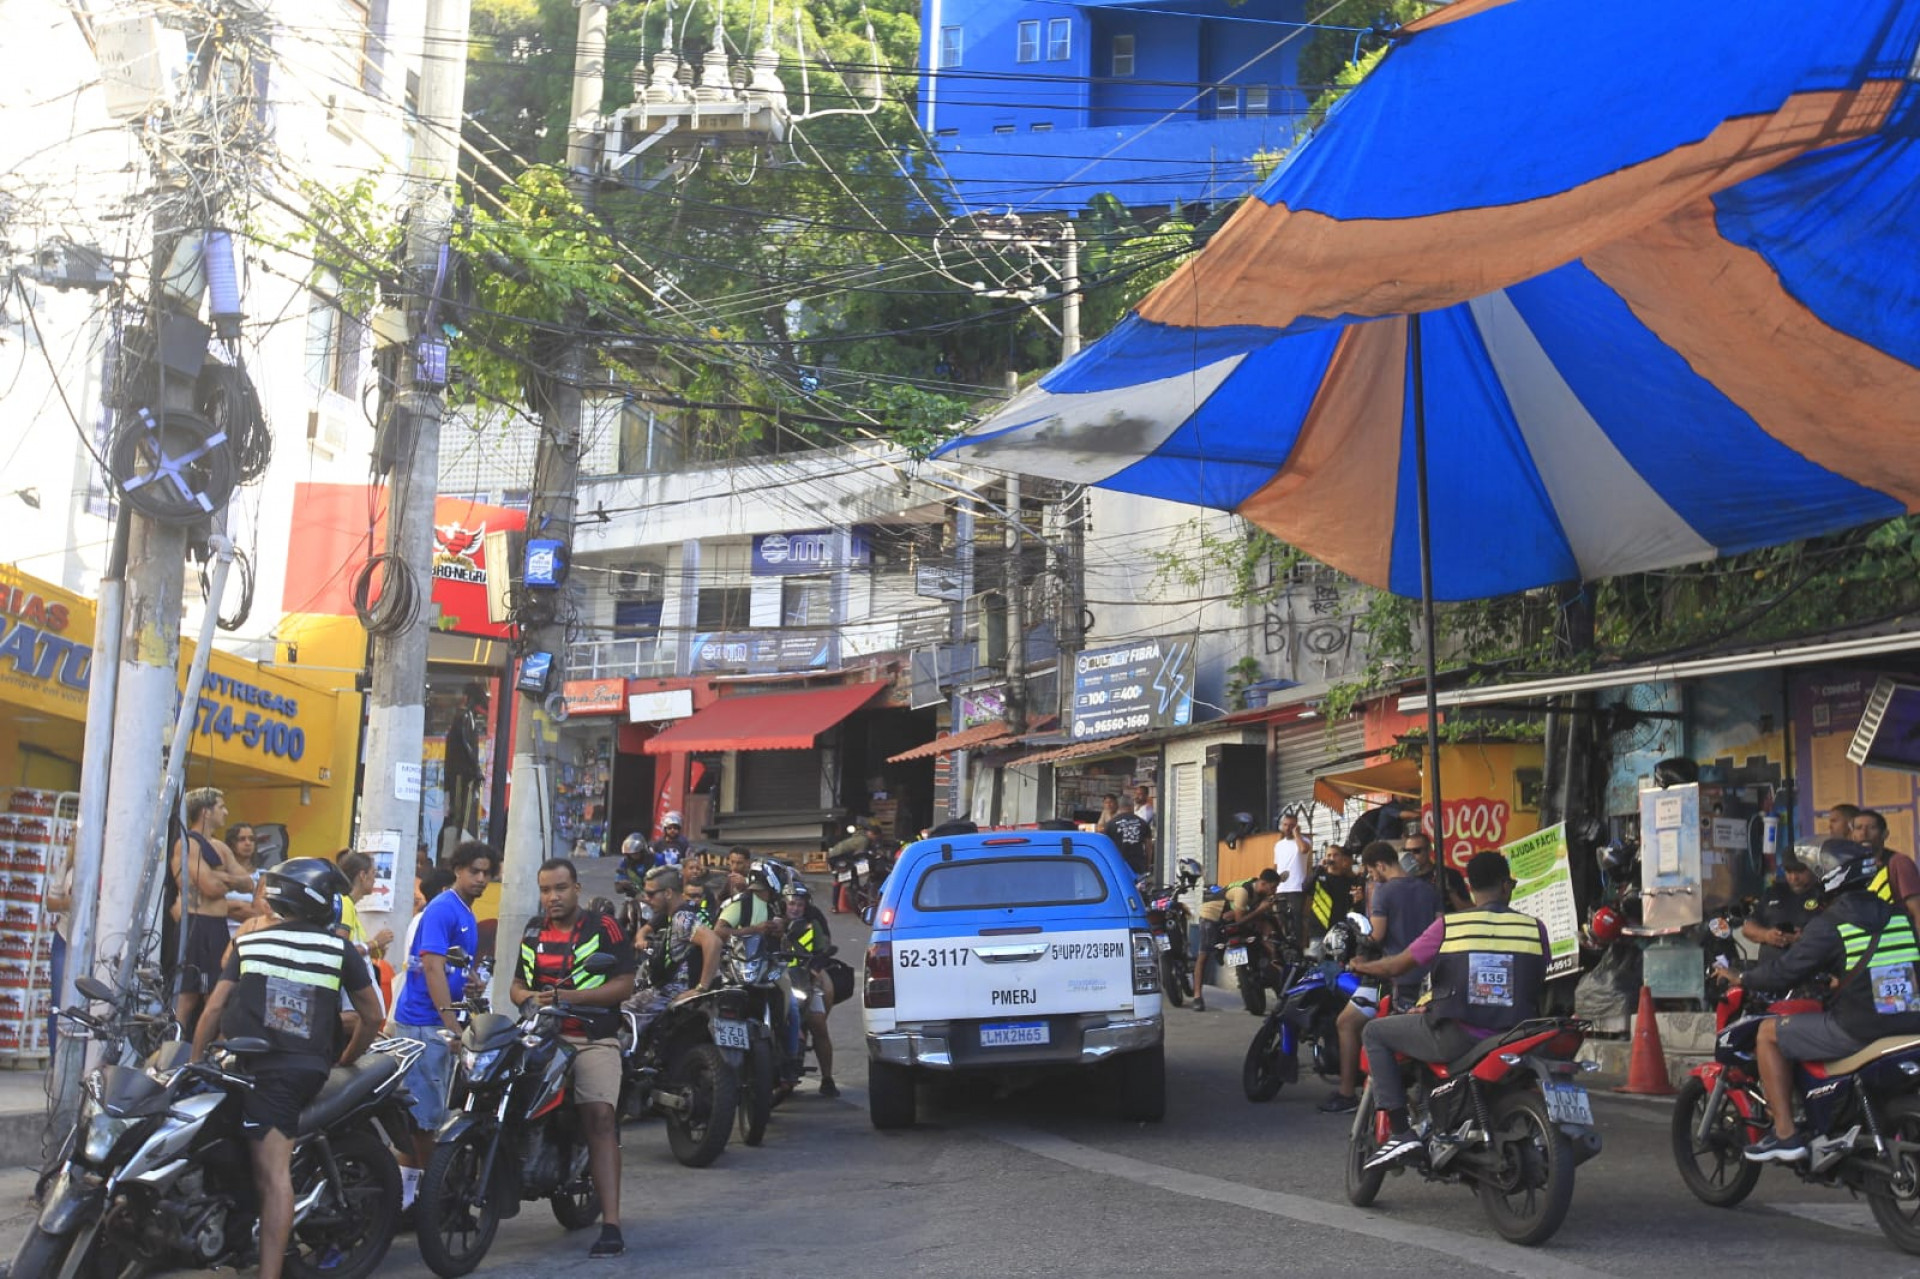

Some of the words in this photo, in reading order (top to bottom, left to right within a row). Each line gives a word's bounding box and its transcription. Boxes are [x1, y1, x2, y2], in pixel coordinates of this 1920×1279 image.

[0, 614, 93, 691] ATO
[1129, 644, 1160, 663] FIBRA
[187, 664, 299, 718] NTREGAS
[175, 690, 305, 762] 74-5100
[900, 948, 969, 968] 52-3117
[1481, 972, 1504, 983] 135
[991, 988, 1037, 1006] PMERJ
[1884, 983, 1908, 995] 332
[279, 996, 302, 1010] 141
